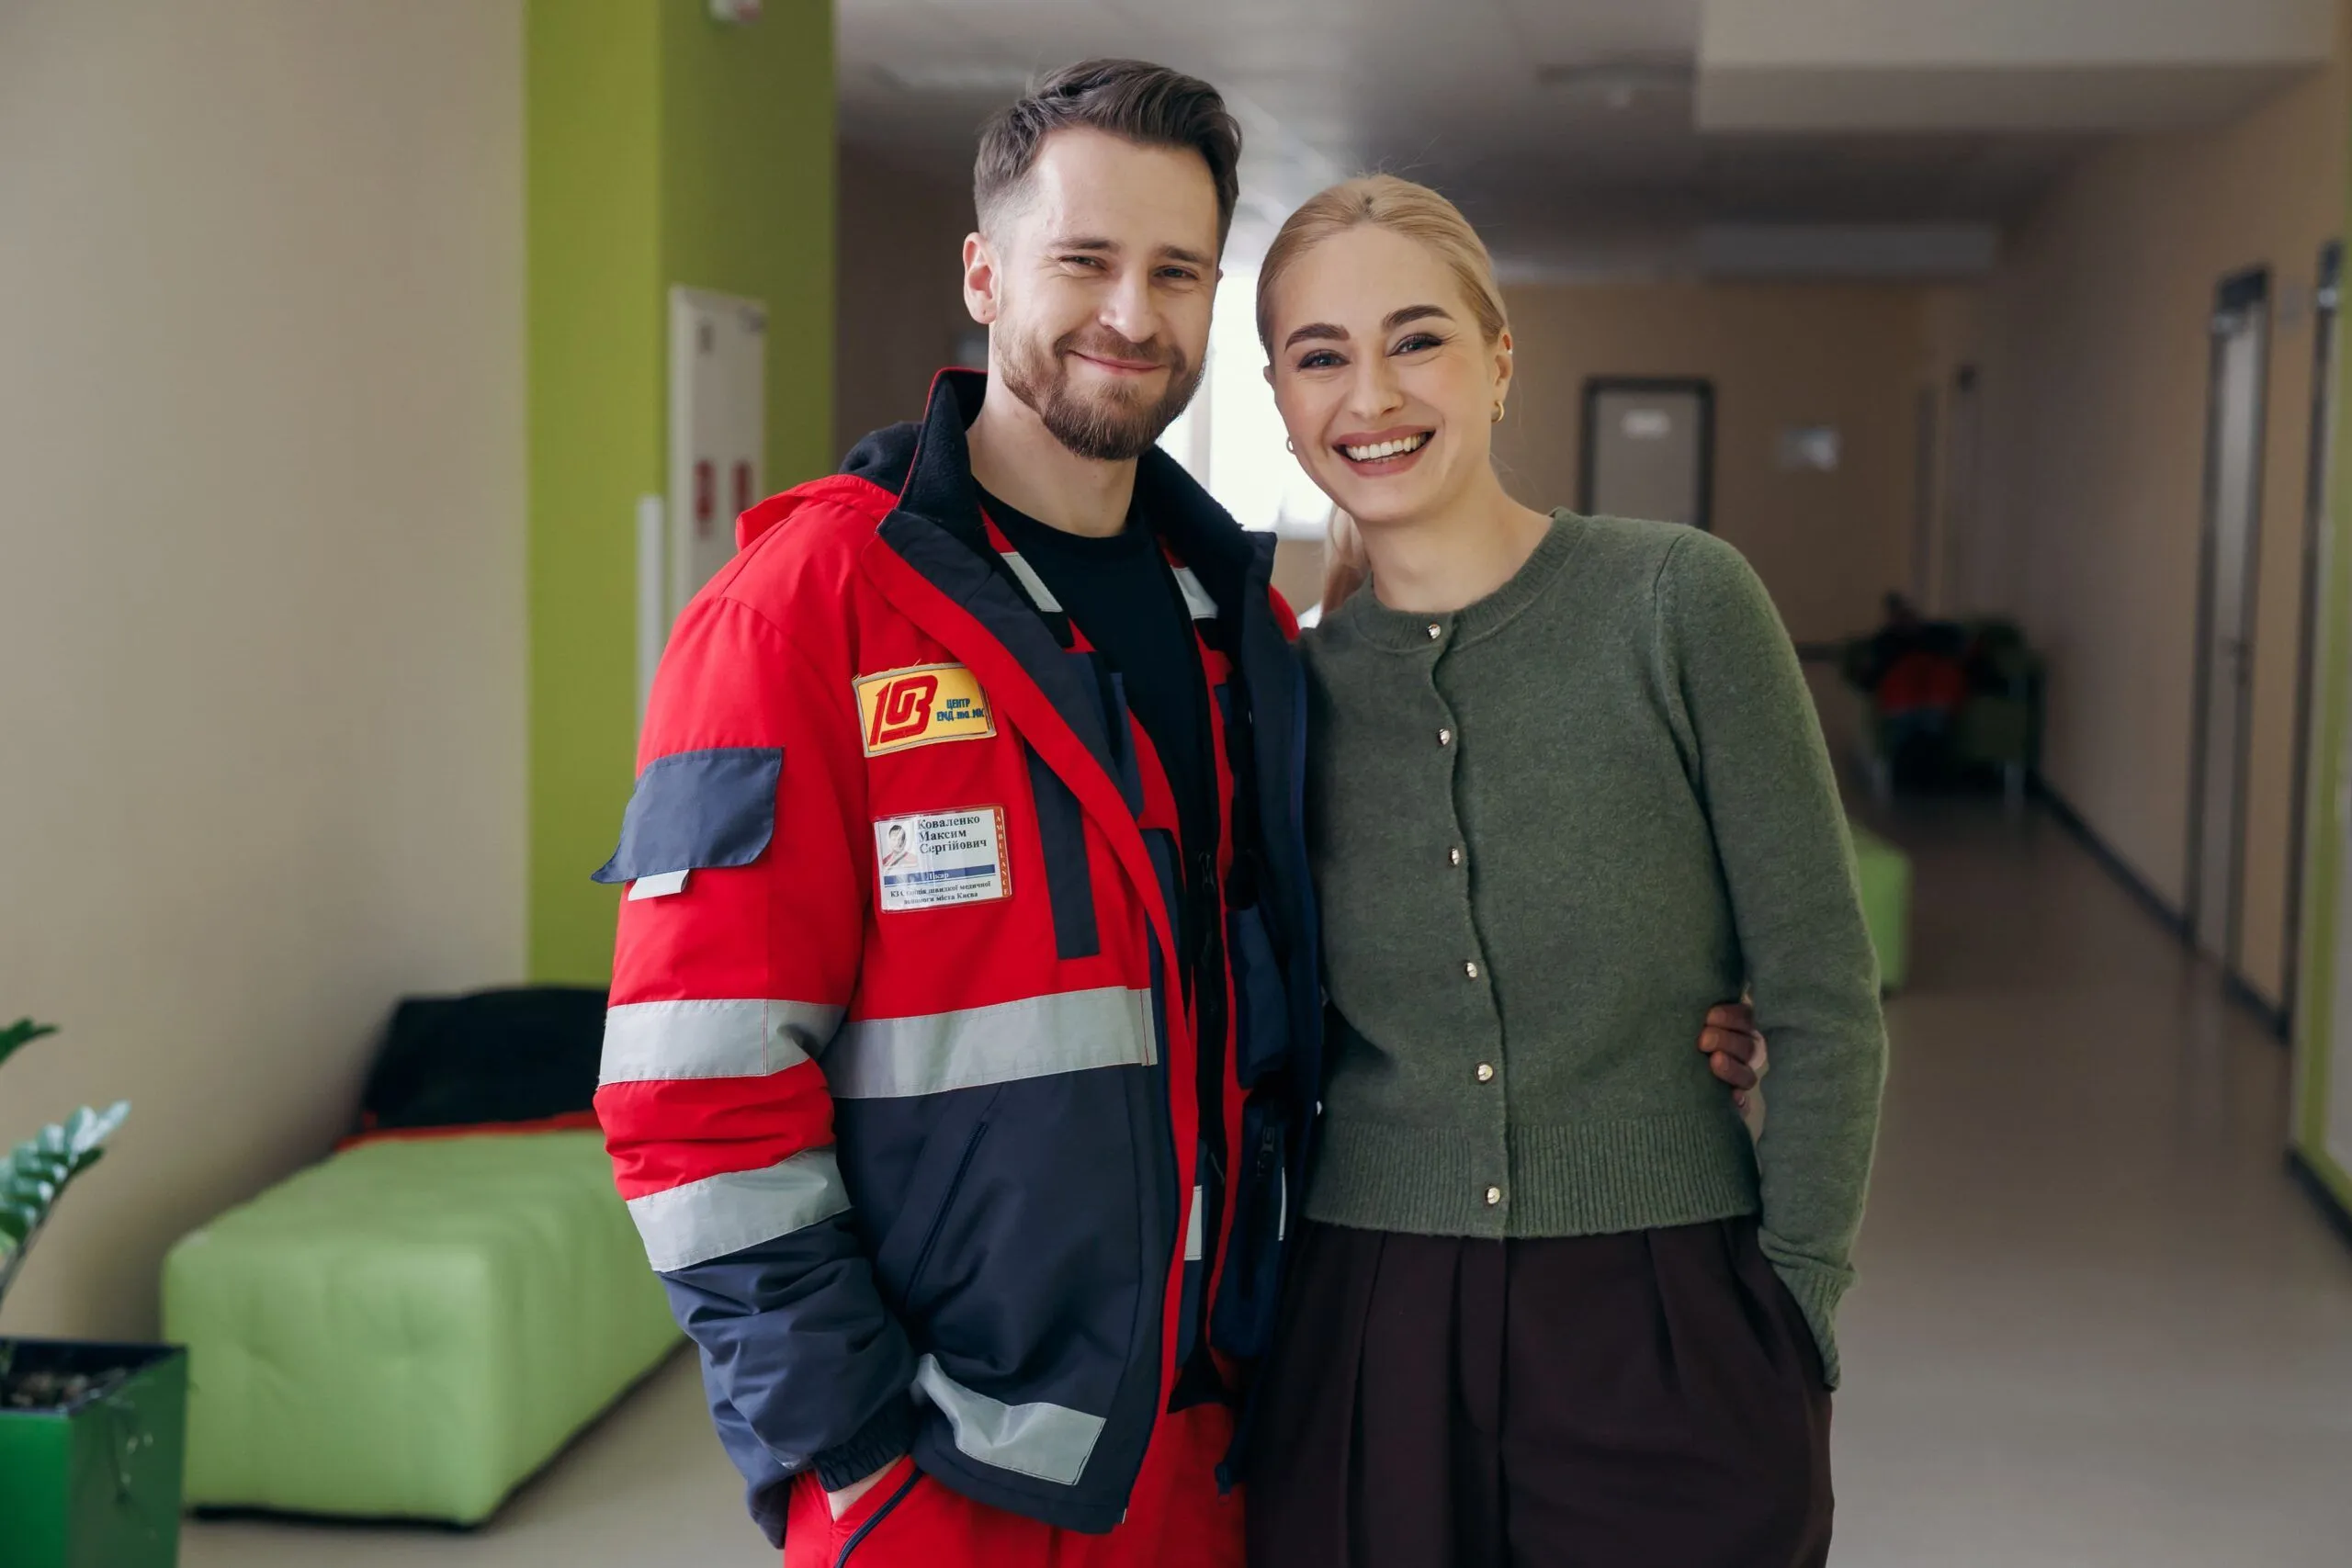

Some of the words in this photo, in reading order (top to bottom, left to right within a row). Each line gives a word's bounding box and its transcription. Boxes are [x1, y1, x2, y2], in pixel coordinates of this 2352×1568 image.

[869, 674, 938, 746] 103
[946, 698, 970, 710] ЦЕНТР
[918, 816, 980, 829] Коваленко
[919, 829, 967, 842] Максим
[920, 840, 987, 855] Сергійович
[960, 881, 991, 890] медичної
